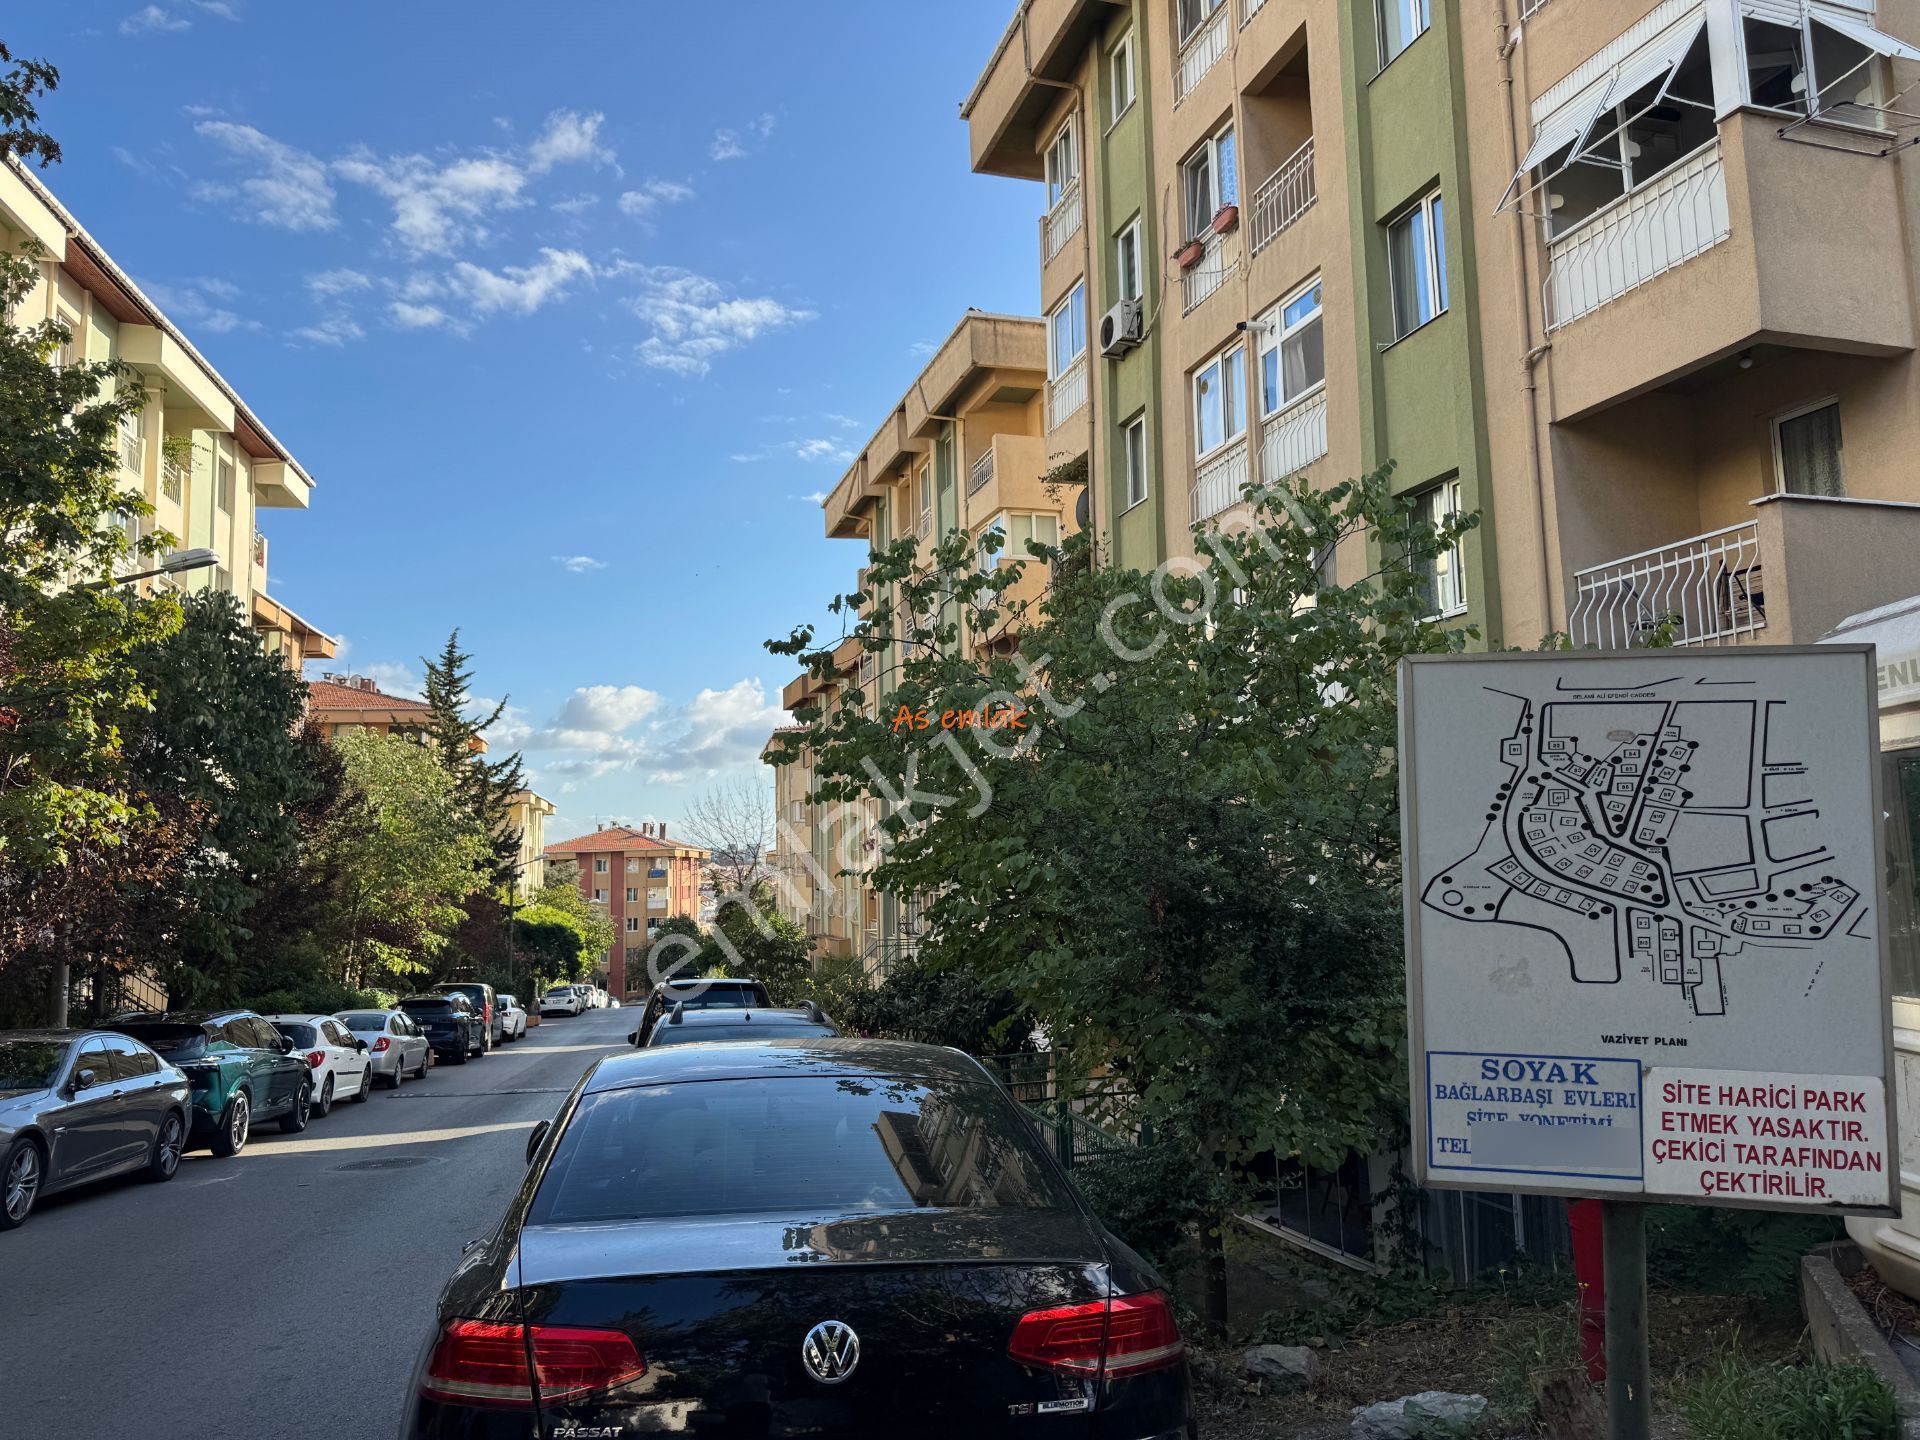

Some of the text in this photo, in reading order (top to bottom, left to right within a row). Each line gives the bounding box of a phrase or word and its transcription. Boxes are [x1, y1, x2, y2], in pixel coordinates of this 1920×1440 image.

[1601, 1033, 1687, 1046] VAZİYET PLANI
[1481, 1058, 1599, 1085] SOYAK
[1434, 1081, 1553, 1108] BAĞLARBAŞI
[1662, 1079, 1867, 1113] SİTE HARİCİ PARK
[1661, 1111, 1869, 1142] ETMEK YASAKTIR.
[1652, 1137, 1882, 1172] ÇEKİCİ TARAFINDAN
[1700, 1169, 1833, 1198] ÇEKTİRİLİR.
[552, 1426, 623, 1438] PASSAT
